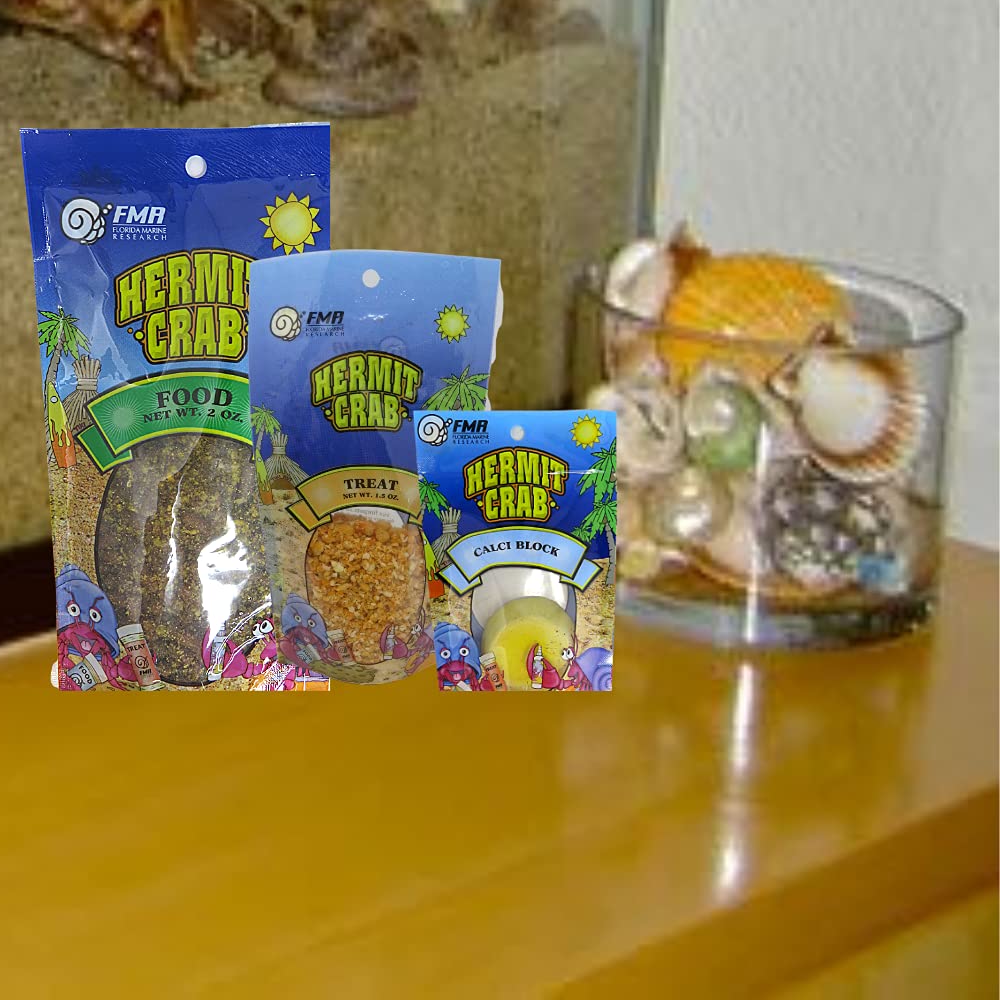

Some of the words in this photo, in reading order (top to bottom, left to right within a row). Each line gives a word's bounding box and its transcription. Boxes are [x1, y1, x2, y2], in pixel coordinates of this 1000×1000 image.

[112, 205, 166, 225] FMR
[112, 226, 141, 234] FLORIDA
[116, 251, 250, 324] HERMI
[306, 311, 345, 325] FMR
[145, 304, 244, 361] CRAB
[313, 354, 420, 403] HERMIT
[156, 387, 233, 409] FOOD
[143, 409, 172, 424] NET
[176, 407, 202, 418] WT.
[207, 408, 216, 418] 2
[221, 409, 244, 424] OZ.
[333, 392, 400, 429] CRAB
[452, 419, 489, 433] FMR
[465, 450, 566, 496] HERMIT
[343, 478, 399, 491] TREAT
[342, 492, 358, 500] NET
[387, 493, 399, 501] OZ.
[484, 486, 549, 520] CRAB
[473, 541, 512, 558] CALCI
[516, 540, 561, 557] BLOCK
[126, 643, 146, 653] TREAT
[78, 664, 93, 685] FOOD
